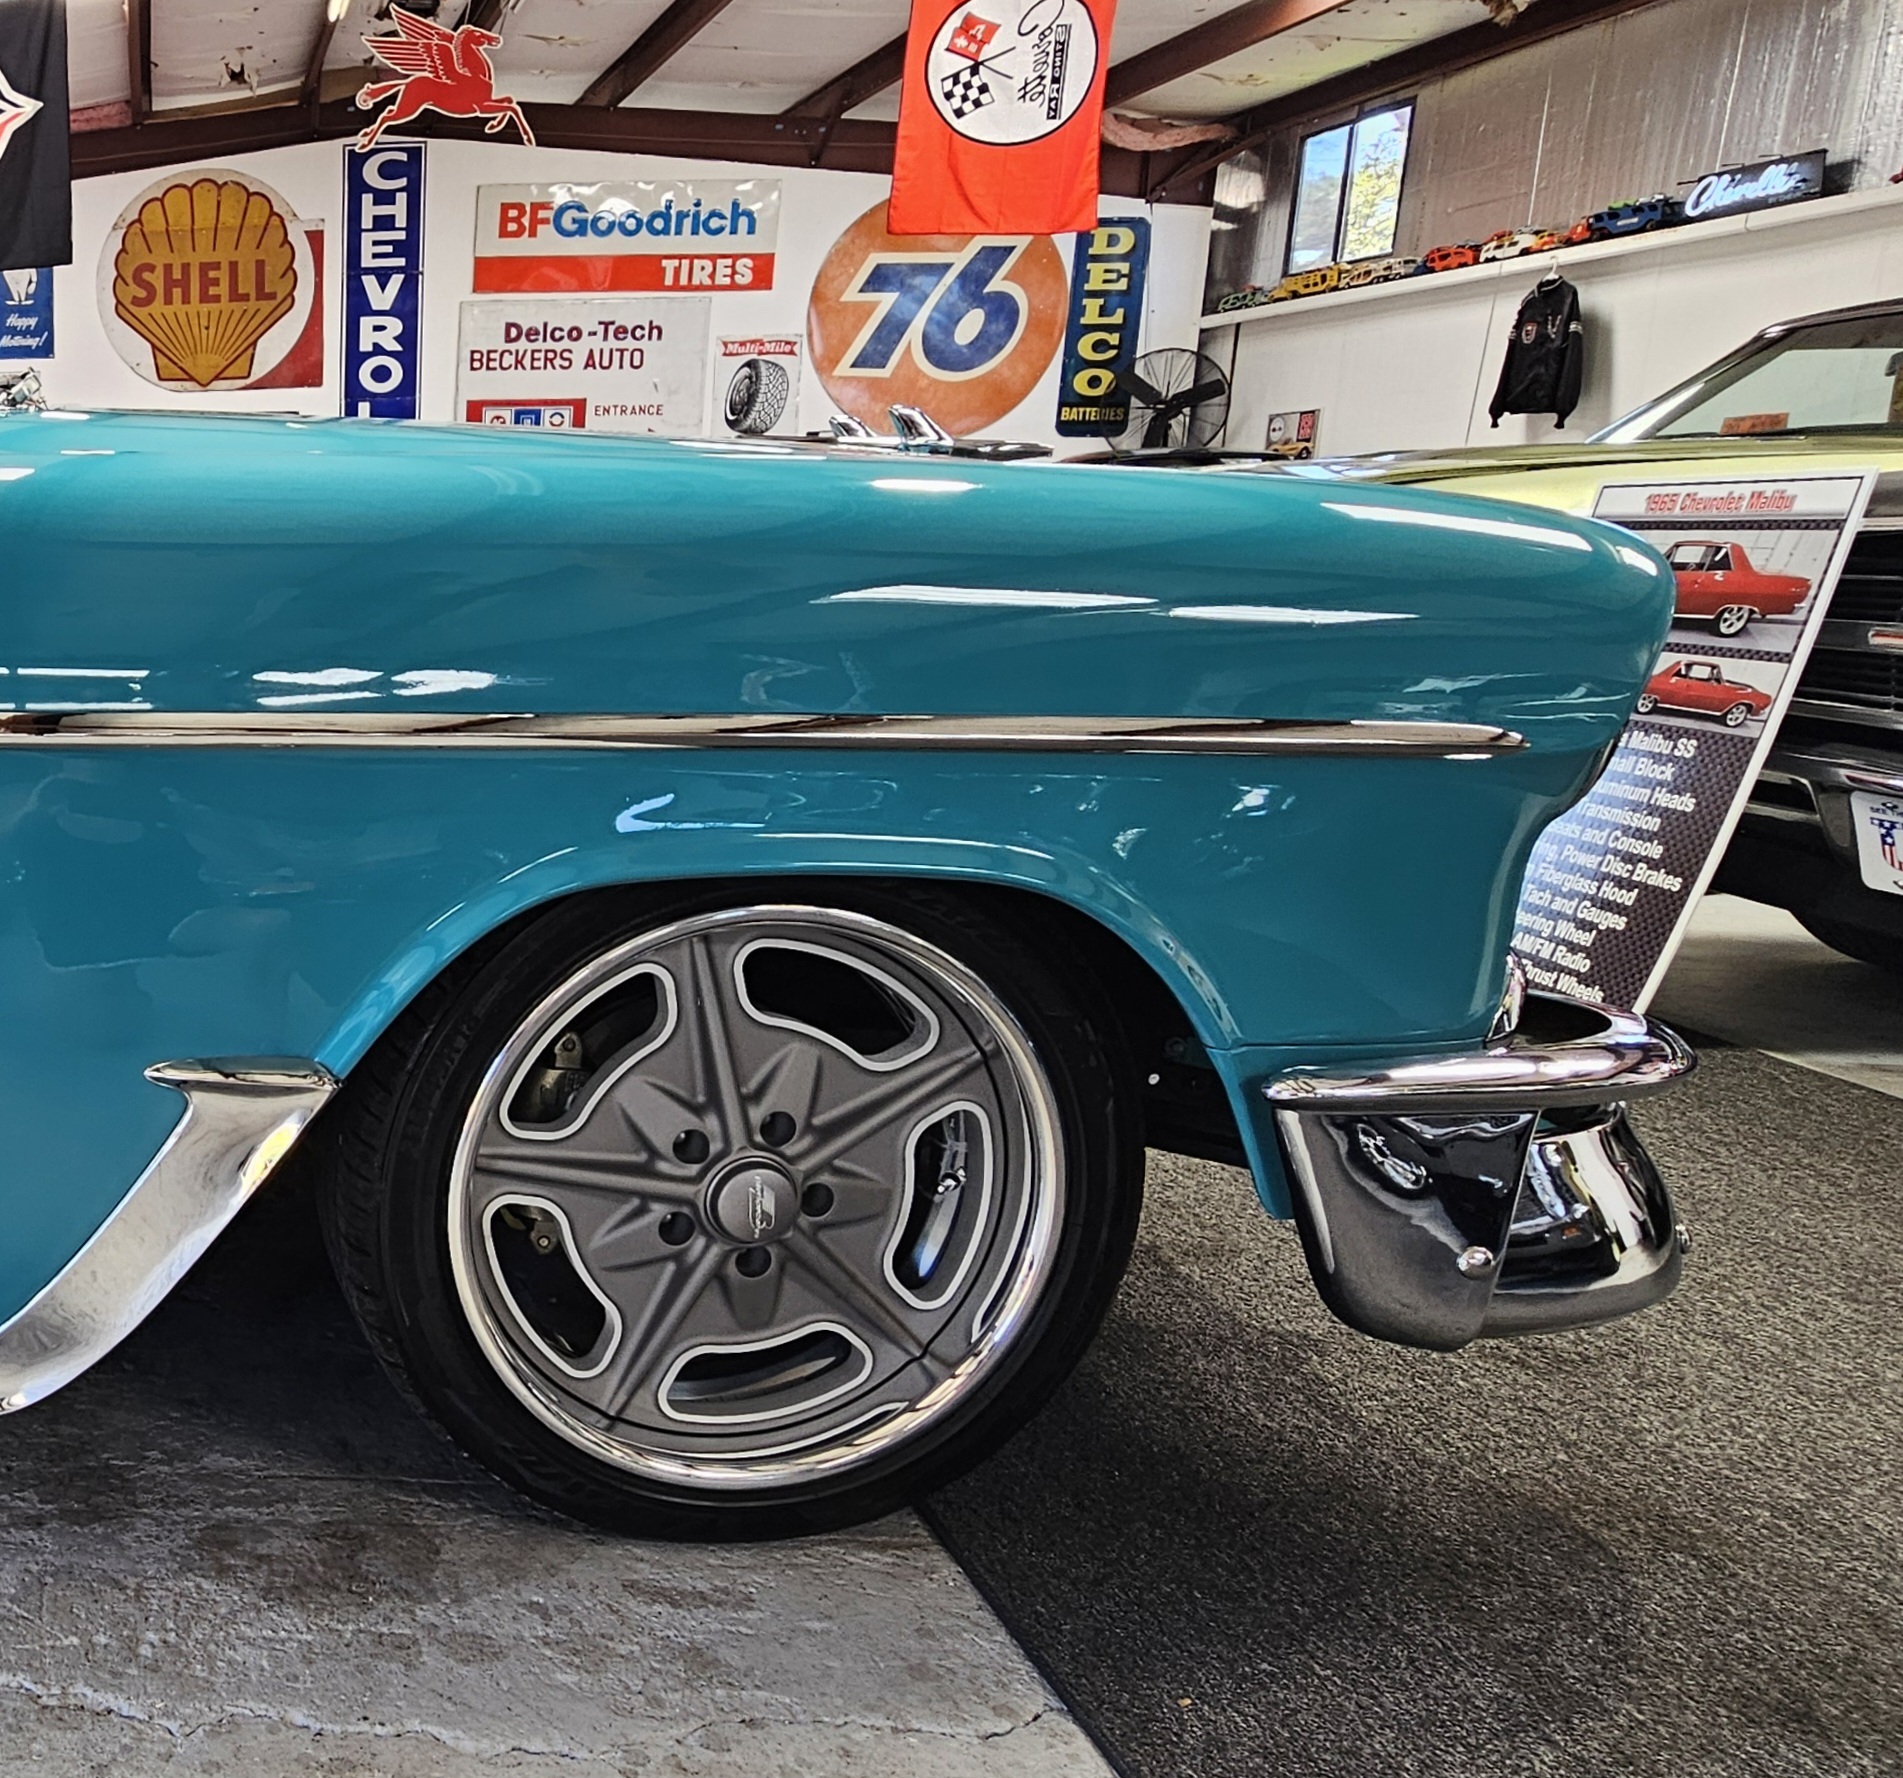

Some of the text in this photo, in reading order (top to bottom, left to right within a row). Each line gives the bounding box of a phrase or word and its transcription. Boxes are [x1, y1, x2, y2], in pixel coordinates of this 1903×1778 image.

[498, 198, 756, 239] BFGoodrich
[130, 259, 277, 308] SHELL
[661, 258, 754, 287] TIRES
[5, 313, 39, 331] Happy
[833, 236, 1028, 382] 76
[1072, 227, 1135, 397] DELCO
[469, 348, 645, 372] BECKERS AUTO
[725, 341, 792, 355] Multi-Mile
[594, 404, 664, 417] ENTRANCE
[1060, 406, 1125, 421] BATTERIES
[1645, 489, 1798, 513] 1965 Chevrolet Malibu
[1627, 730, 1673, 755] Malibu
[1673, 738, 1698, 758] SS
[1634, 757, 1676, 781] Block
[1649, 787, 1697, 812] Heads
[1581, 828, 1609, 845] and
[1607, 830, 1664, 859] Console
[1560, 844, 1603, 872] Power
[1600, 855, 1634, 879] Disc
[1631, 862, 1684, 892] Brakes
[1534, 863, 1599, 896] Fiberglass
[1598, 880, 1639, 906] Hood
[1523, 883, 1628, 931] Tach and Gauges
[1553, 918, 1597, 947] Wheel
[1552, 944, 1591, 973] Radio
[1556, 972, 1605, 1003] Wheels
